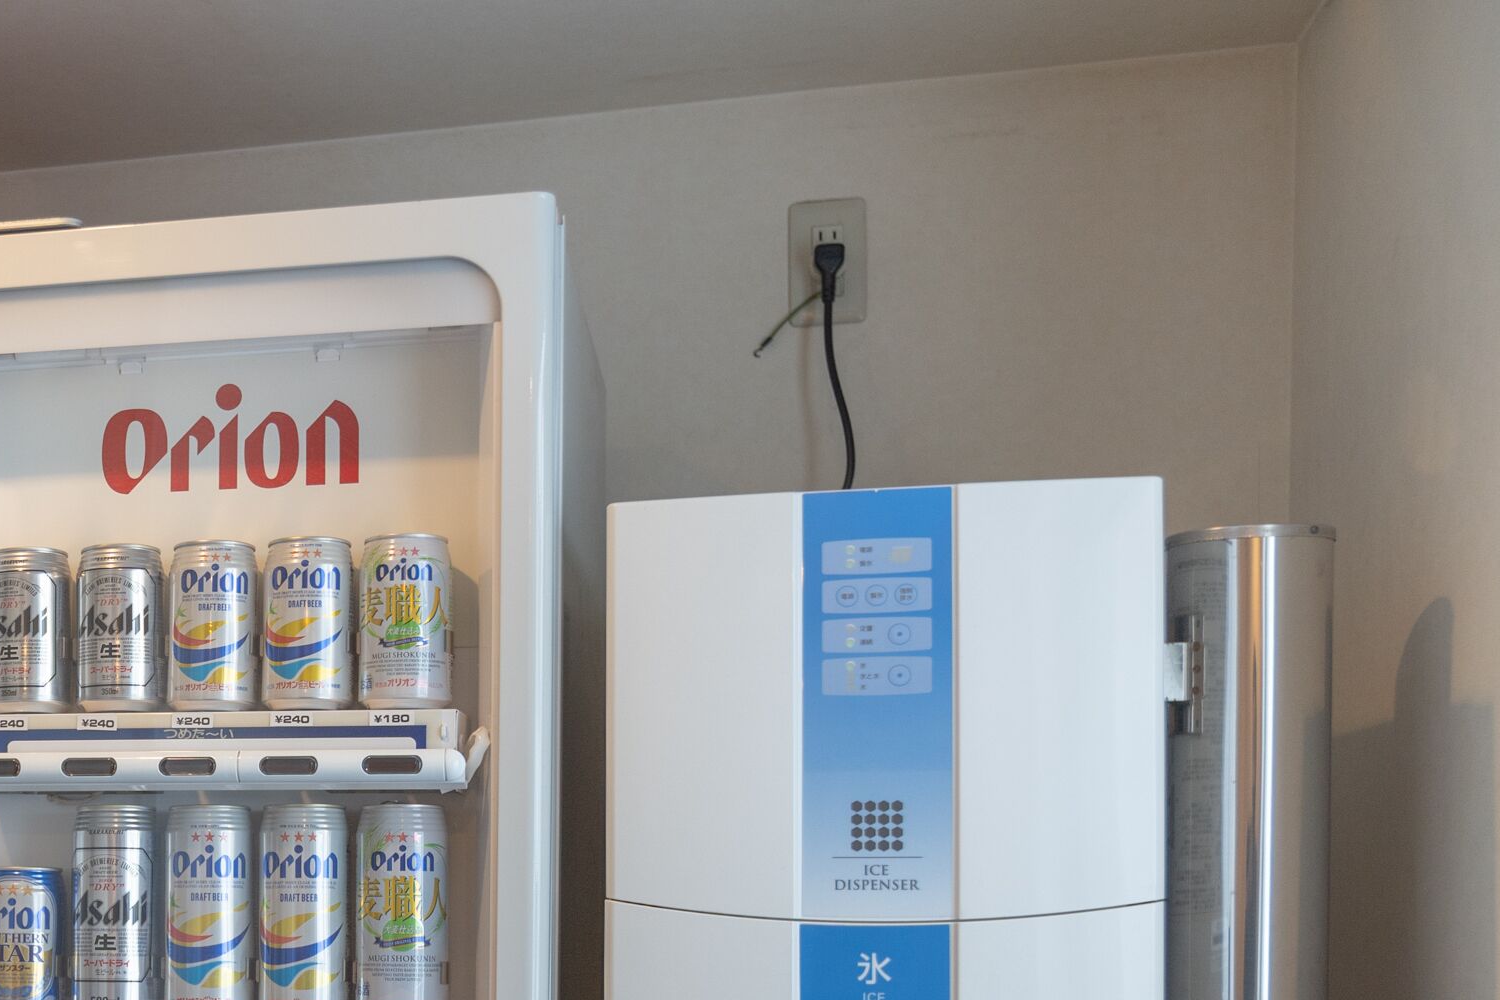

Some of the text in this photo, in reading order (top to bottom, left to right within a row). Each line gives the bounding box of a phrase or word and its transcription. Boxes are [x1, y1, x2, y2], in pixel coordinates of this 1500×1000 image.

[102, 383, 360, 495] Orion
[181, 563, 249, 594] Orion
[272, 559, 341, 591] Orion
[375, 558, 433, 583] Orion
[198, 602, 217, 612] DRAFT
[288, 600, 323, 609] DRAFT BEER
[360, 583, 449, 630] 麦職人
[79, 603, 150, 640] Asahi
[0, 644, 20, 662] 生
[100, 643, 122, 659] 生
[371, 651, 436, 660] MUGI SHOKUNIN
[90, 665, 133, 674] スーパードライ
[82, 718, 115, 728] ¥240
[177, 716, 210, 726] ¥240
[275, 715, 310, 724] ¥240
[374, 714, 410, 724] ¥180
[172, 844, 246, 879] Orion
[263, 844, 338, 879] Orion
[371, 844, 435, 873] Orion
[863, 864, 890, 877] ICE
[834, 878, 920, 892] DISPENSER
[191, 892, 211, 902] DRAFT
[280, 892, 318, 903] DRAFT BEER
[357, 875, 449, 923] 麦職人
[74, 890, 147, 927] Asahi
[94, 933, 117, 951] 生
[83, 959, 131, 968] スーパードライ
[368, 954, 437, 963] MUGI SHOKUNIN
[857, 951, 892, 985] 氷
